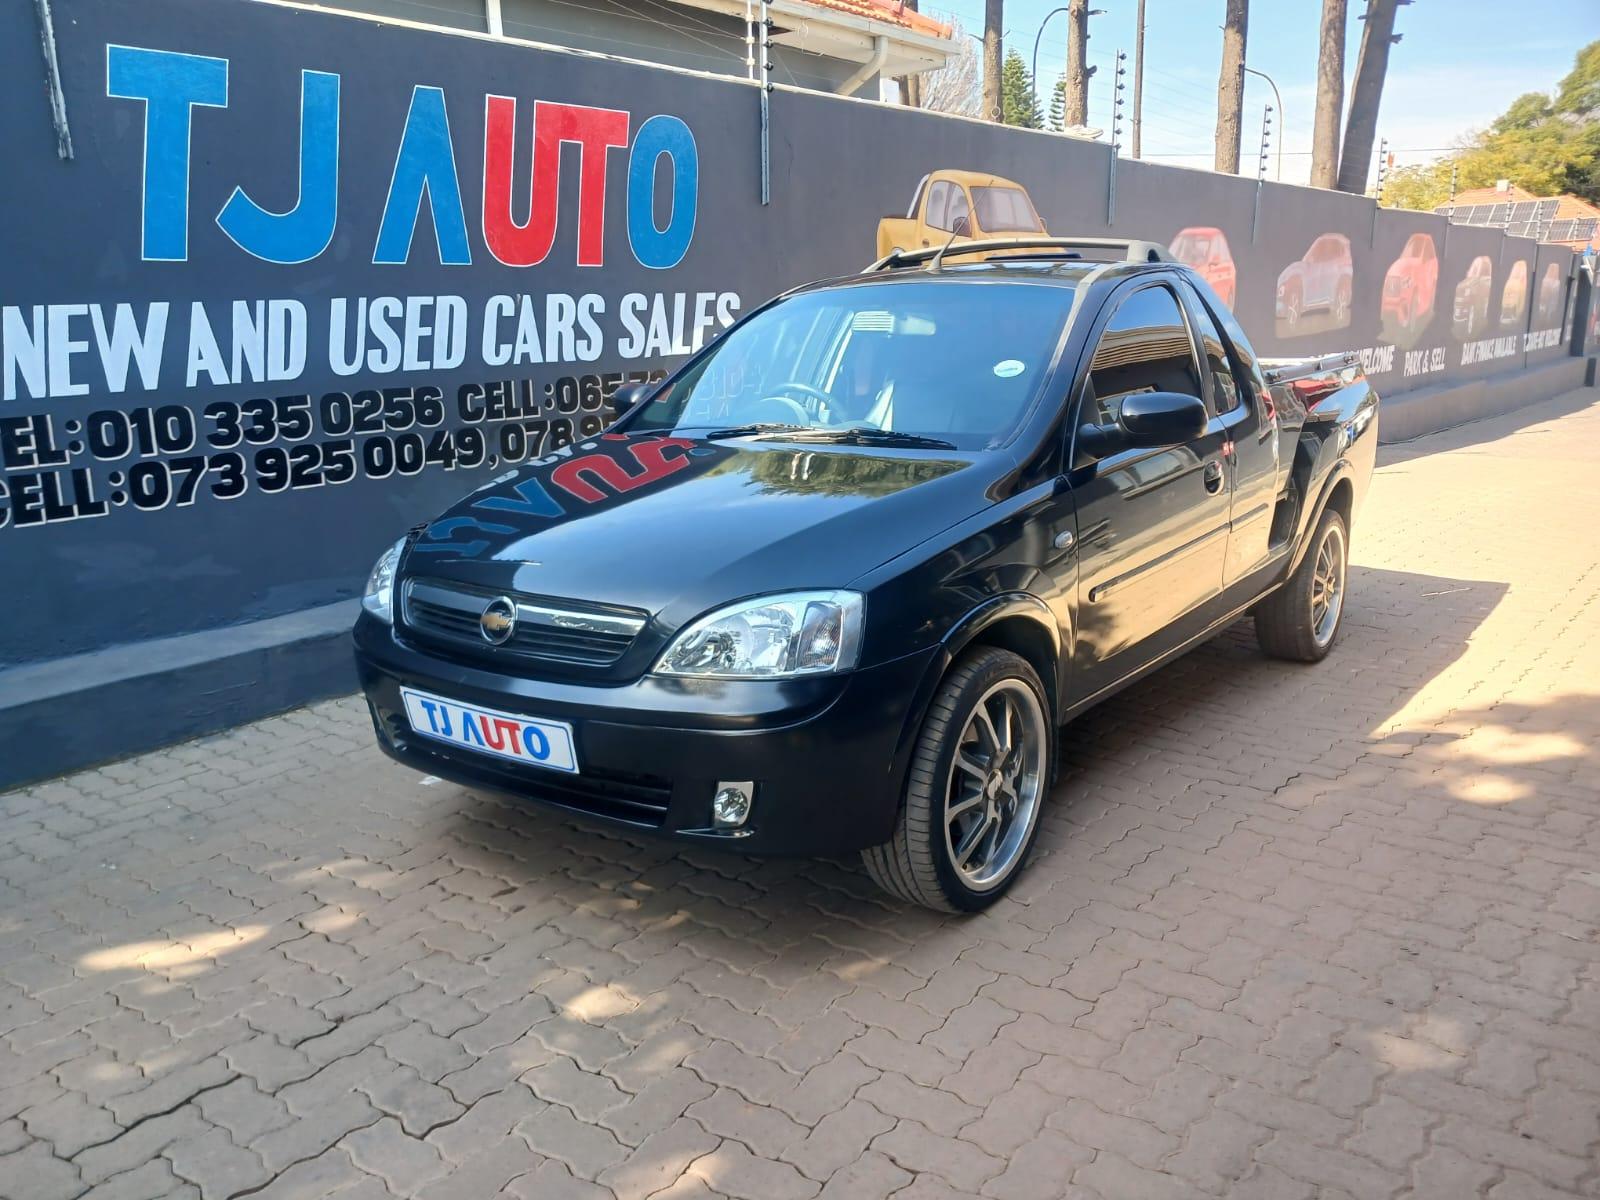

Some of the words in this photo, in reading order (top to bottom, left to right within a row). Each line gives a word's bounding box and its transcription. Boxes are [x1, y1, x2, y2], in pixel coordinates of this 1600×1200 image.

[106, 43, 341, 264] TJ
[371, 84, 698, 269] AUTO
[2, 301, 170, 401] NEW
[186, 299, 306, 388] AND
[328, 296, 467, 379] USED
[482, 293, 605, 366] CARS
[1403, 350, 1423, 377] PARK
[1430, 346, 1446, 372] SELL
[203, 394, 313, 449] 335
[319, 384, 445, 437] 0256
[254, 438, 357, 493] 925
[420, 700, 453, 737] TJ
[462, 704, 551, 761] AUTO
